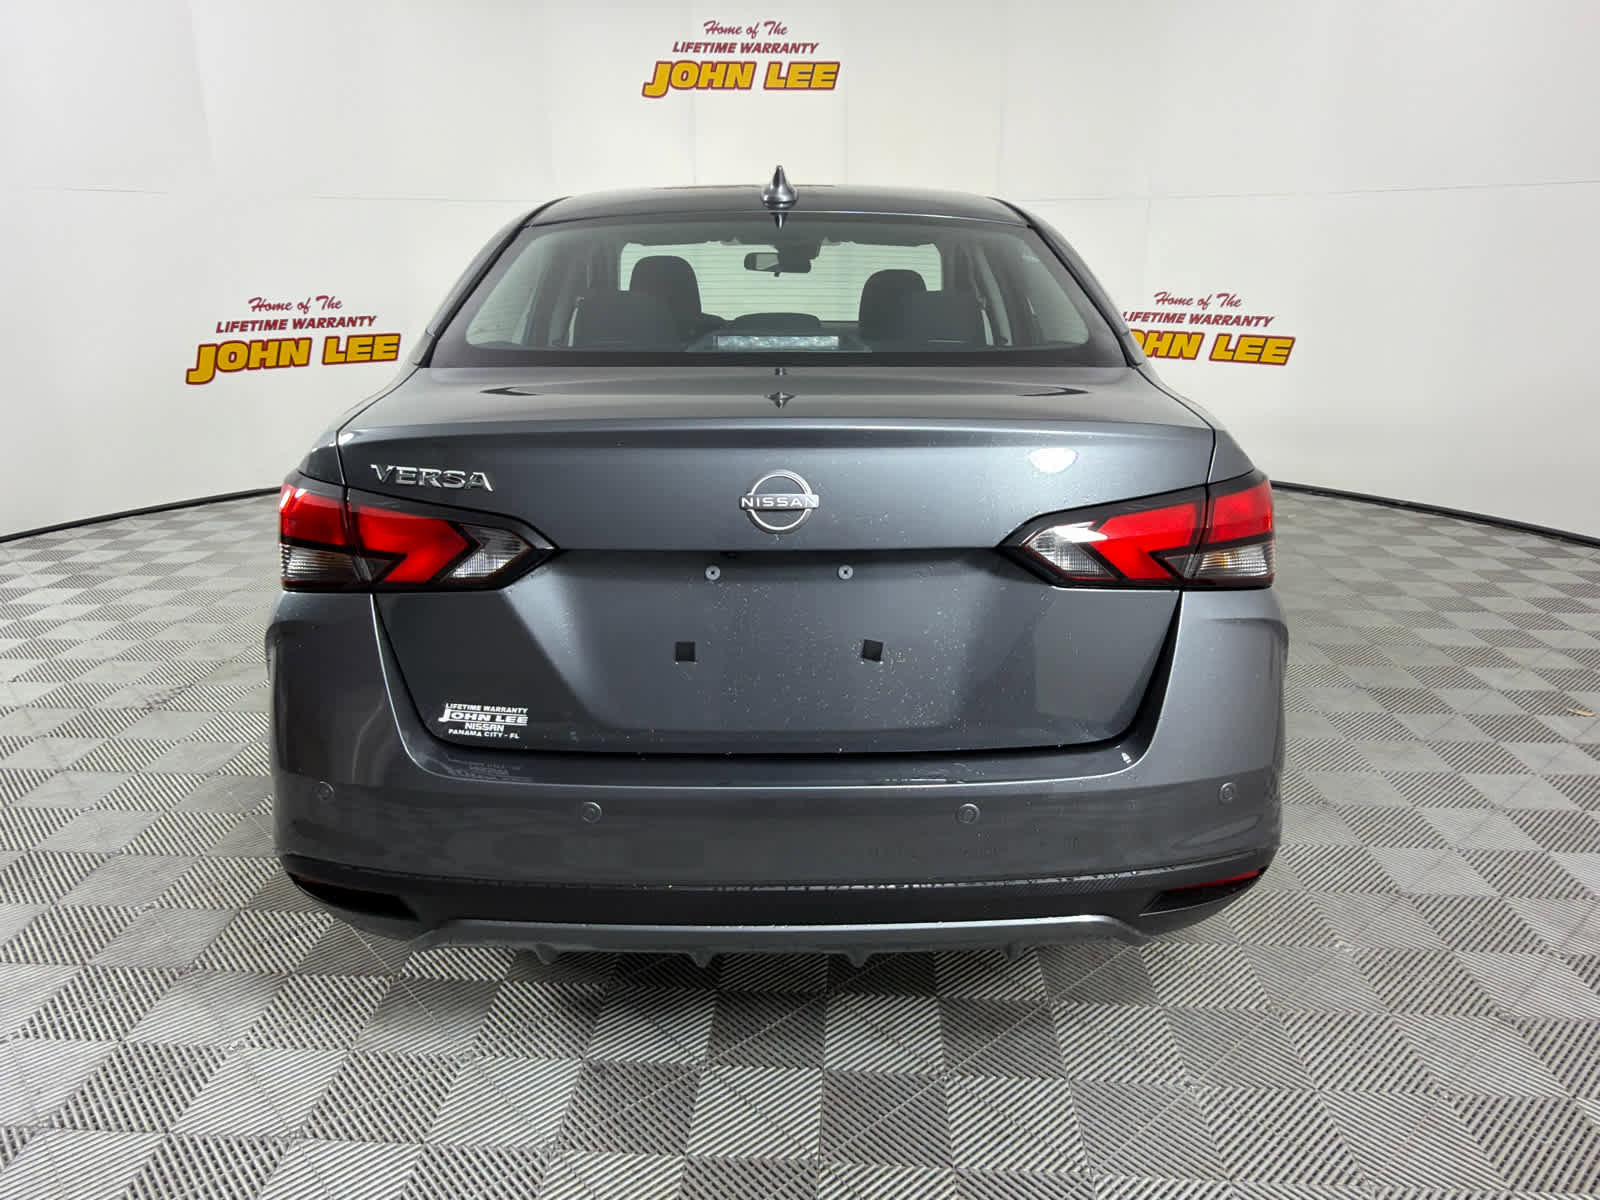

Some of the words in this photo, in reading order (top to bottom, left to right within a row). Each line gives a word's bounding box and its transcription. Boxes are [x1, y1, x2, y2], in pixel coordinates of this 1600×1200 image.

[703, 20, 743, 36] Home
[746, 22, 760, 39] of
[763, 20, 789, 36] The
[672, 41, 737, 54] LIFETIME
[739, 42, 820, 55] WARRANTY
[642, 60, 757, 98] JOHN
[763, 61, 841, 90] LEE
[248, 296, 293, 313] Home
[296, 297, 311, 315] of
[315, 295, 342, 311] The
[1154, 291, 1194, 307] Home
[1197, 294, 1212, 311] of
[1216, 292, 1242, 308] The
[216, 318, 288, 334] LIFETIME
[292, 315, 377, 330] WARRANTY
[1189, 313, 1275, 328] WARRANTY
[1129, 328, 1205, 360] HN
[1208, 333, 1296, 366] LEE
[185, 337, 312, 385] JOHN
[322, 333, 401, 365] LEE
[370, 464, 494, 492] VERSA
[740, 496, 818, 508] NISSAN
[438, 708, 492, 722] JOHN
[495, 715, 528, 724] LEE
[446, 703, 482, 711] LIFETIME
[483, 705, 528, 714] WARRANTY
[448, 728, 482, 737] PANAMA
[464, 722, 505, 732] NISSAN
